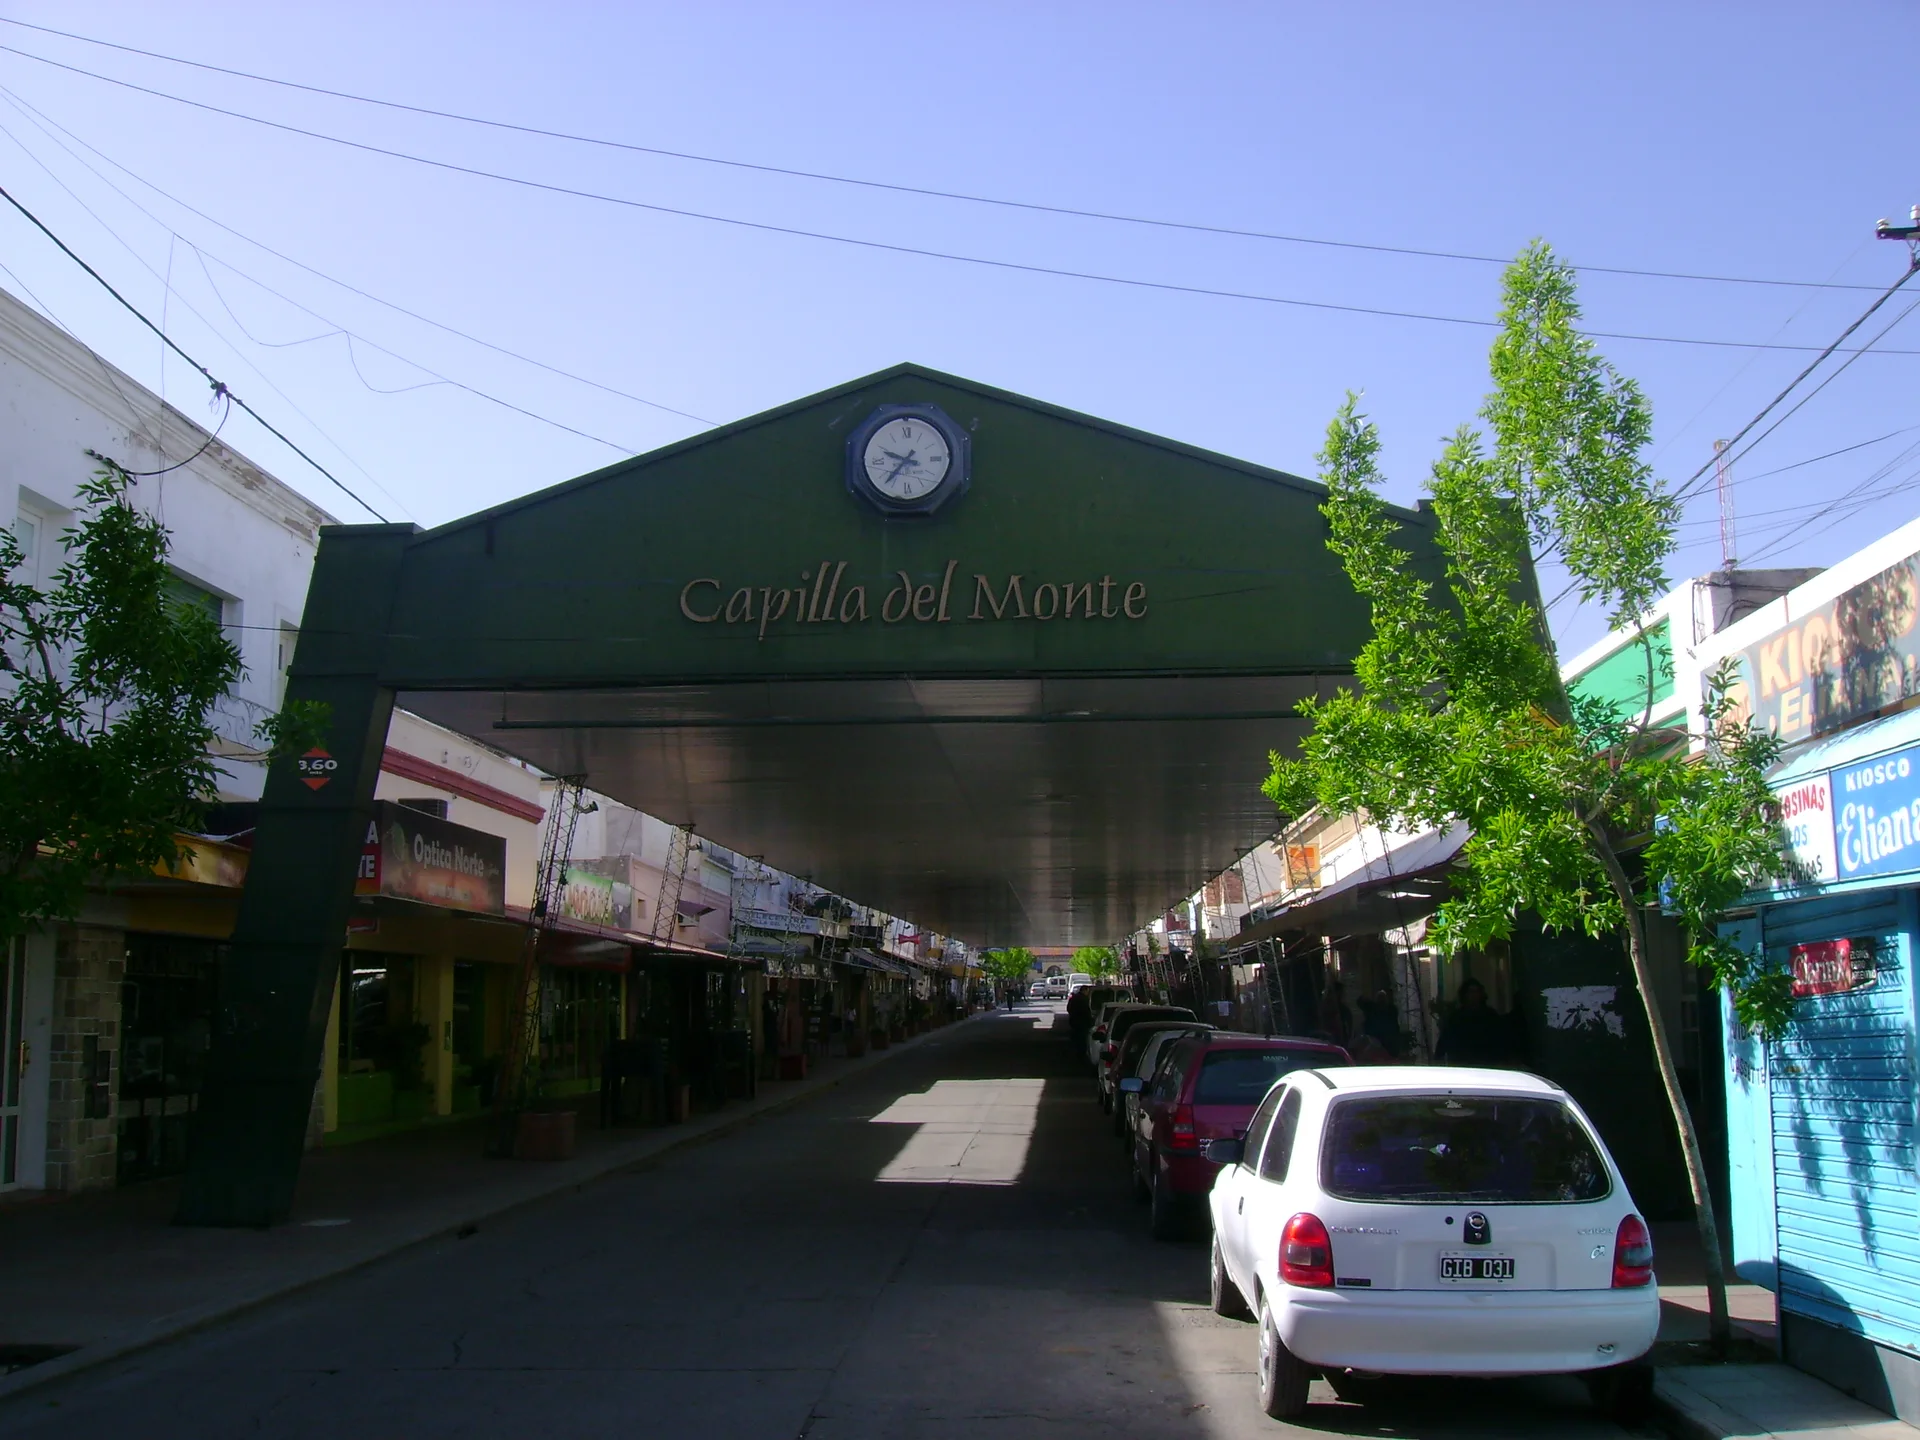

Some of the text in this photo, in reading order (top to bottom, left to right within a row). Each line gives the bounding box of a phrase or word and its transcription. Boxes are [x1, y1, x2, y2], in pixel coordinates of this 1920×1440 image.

[680, 559, 1148, 642] Capilla del Monte
[1845, 757, 1910, 793] KIOSCO
[413, 833, 452, 870] Optica
[454, 845, 485, 877] Norte
[1442, 1259, 1513, 1278] GIB 031
